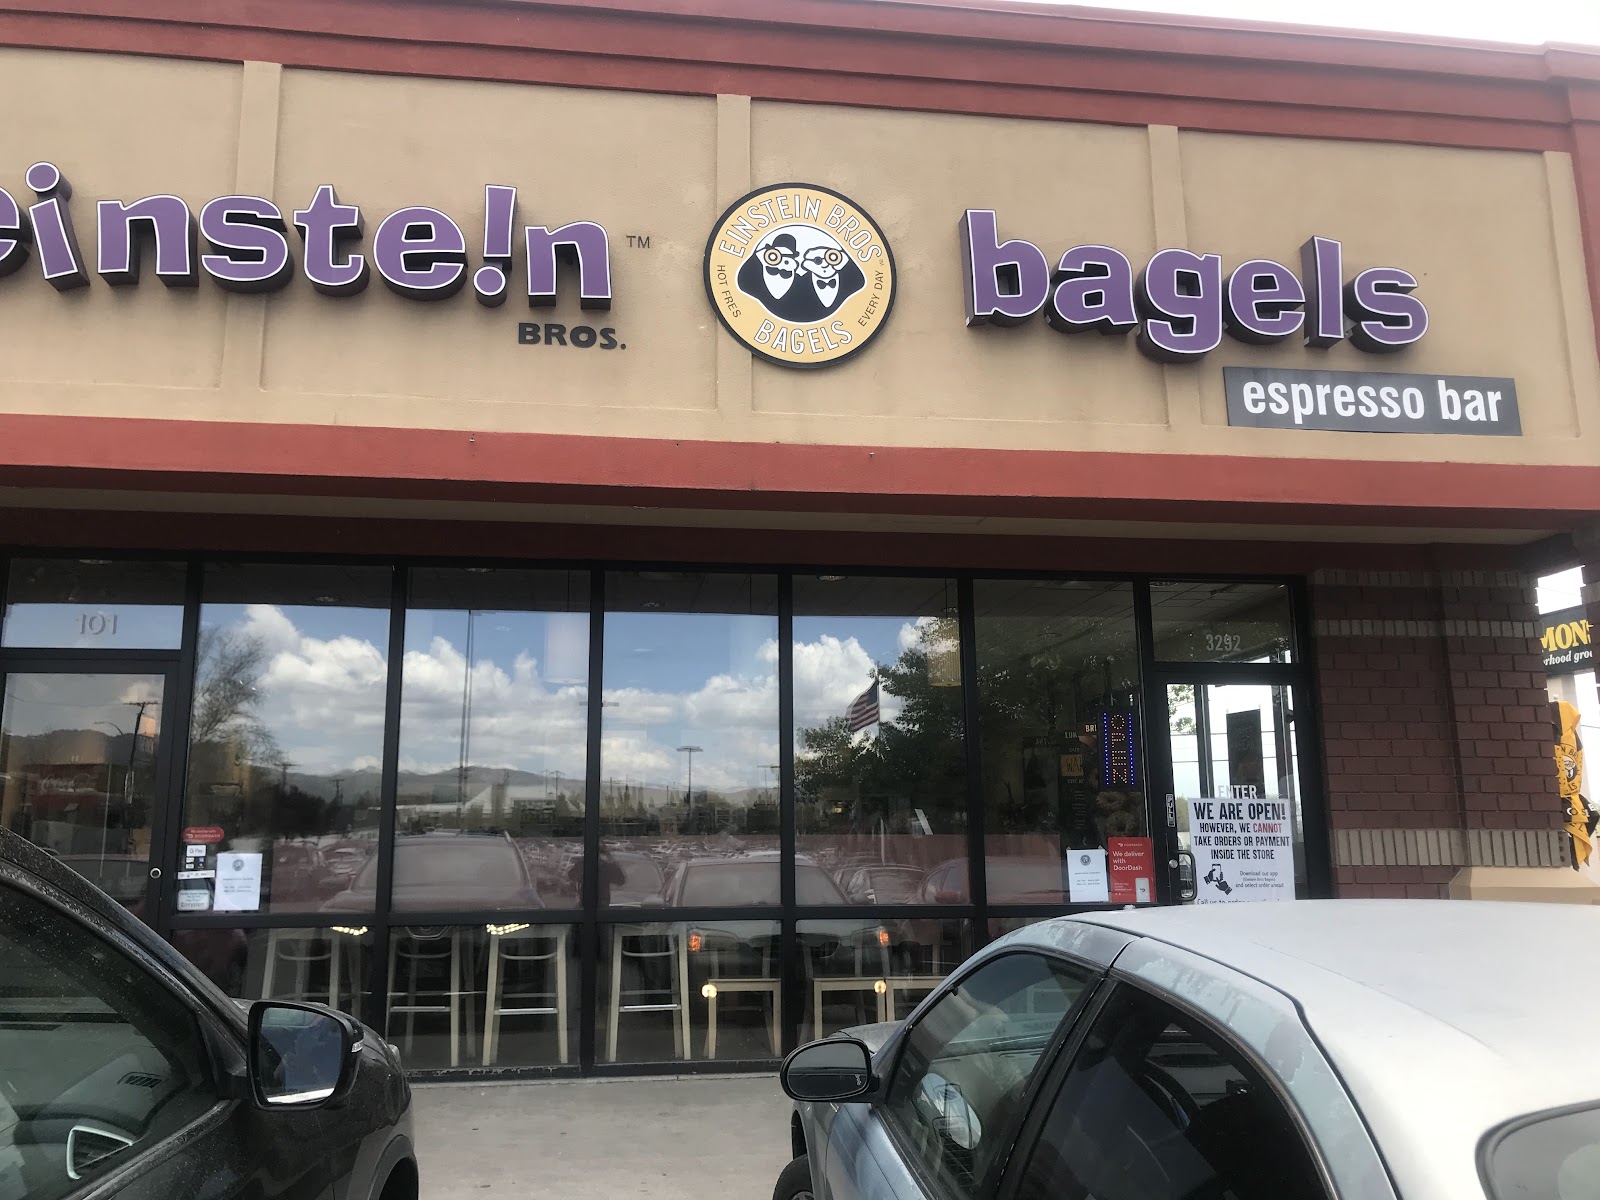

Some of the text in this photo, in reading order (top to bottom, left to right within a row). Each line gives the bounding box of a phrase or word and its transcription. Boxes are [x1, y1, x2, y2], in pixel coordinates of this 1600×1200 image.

[719, 194, 822, 259] EINSTEIN
[825, 203, 882, 263] BROS
[626, 236, 651, 249] TM
[717, 264, 742, 319] HOT FRES
[962, 208, 1430, 356] bagels
[857, 270, 885, 328] EVERY DAY
[517, 322, 627, 351] BROS.
[754, 318, 853, 355] BAGELS
[1242, 379, 1502, 424] espresso bar
[76, 613, 118, 636] 101
[1205, 633, 1241, 652] 3292
[1111, 713, 1128, 785] OPEN
[1218, 784, 1258, 799] ENTER
[1193, 802, 1214, 820] WE
[1219, 802, 1244, 820] ARE
[1248, 802, 1287, 820] OPEN!
[1193, 835, 1290, 846] TAKE ORDERS OR PAYMENT
[1199, 822, 1282, 834] HOWEVER, WE CANNOT
[1210, 849, 1275, 860] INSIDE THE STORE
